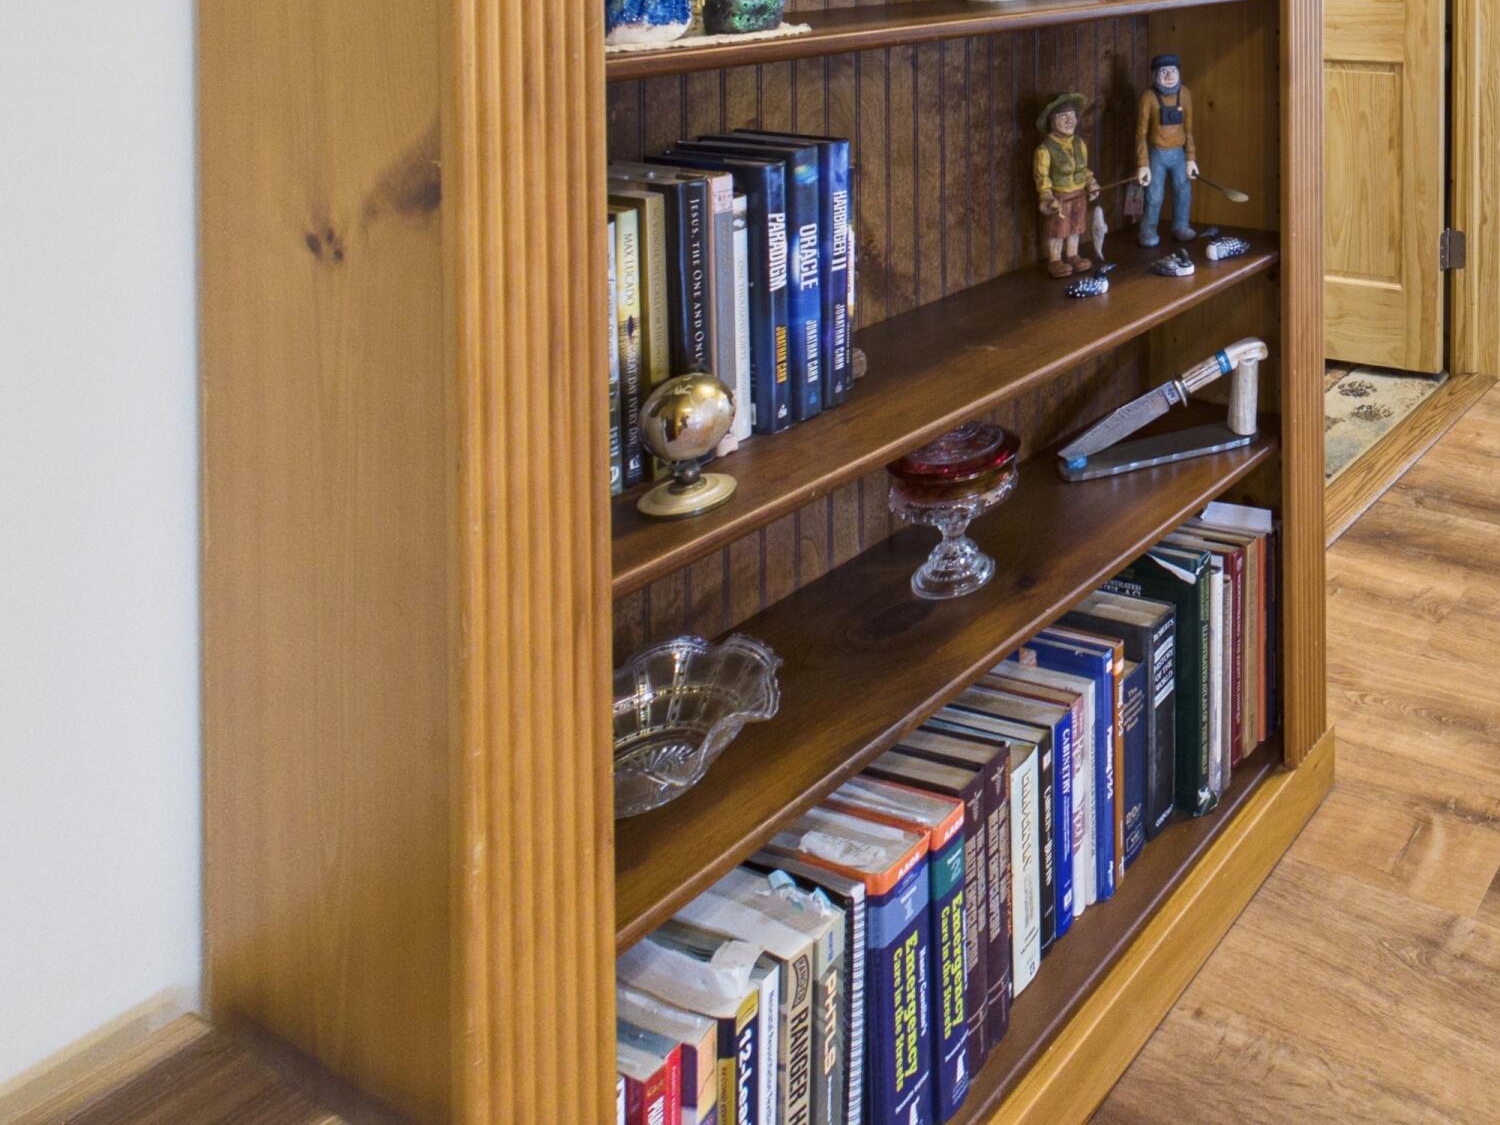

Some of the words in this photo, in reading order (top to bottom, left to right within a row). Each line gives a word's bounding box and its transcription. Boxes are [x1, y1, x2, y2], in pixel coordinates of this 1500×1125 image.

[832, 190, 848, 258] HARBINGER
[624, 233, 634, 257] MAX
[768, 213, 788, 292] PARADIGM
[799, 223, 819, 291] ORACLE
[624, 260, 635, 307] LUCADO
[806, 320, 818, 360] JONATHAN
[834, 304, 846, 346] JONATHAN
[807, 360, 819, 384] CAHN
[834, 346, 845, 371] CAHN
[627, 377, 638, 396] DAY
[628, 397, 638, 424] EVERY
[628, 426, 639, 445] DAY
[1153, 649, 1174, 675] HISTORY
[1154, 669, 1174, 692] WORLD
[1161, 658, 1173, 674] THE
[1062, 728, 1071, 795] CABINETRY
[988, 809, 1000, 857] HEALTH
[964, 835, 978, 885] HEALTH
[988, 854, 1001, 943] ENCYCLOPEDIA
[941, 906, 951, 945] Care
[964, 879, 979, 973] ENCYCLOPEDIA
[893, 947, 903, 987] Care
[942, 941, 952, 962] in
[951, 890, 964, 1026] Emergency
[796, 958, 809, 1005] RANGER
[942, 960, 952, 988] the
[894, 985, 904, 1008] in
[904, 929, 919, 1078] Emergency
[943, 986, 953, 1040] Streets
[824, 969, 838, 1076] PHTLS
[894, 1005, 904, 1035] the
[789, 1006, 809, 1107] RANGER
[895, 1033, 904, 1093] Streets
[788, 1103, 808, 1125] H
